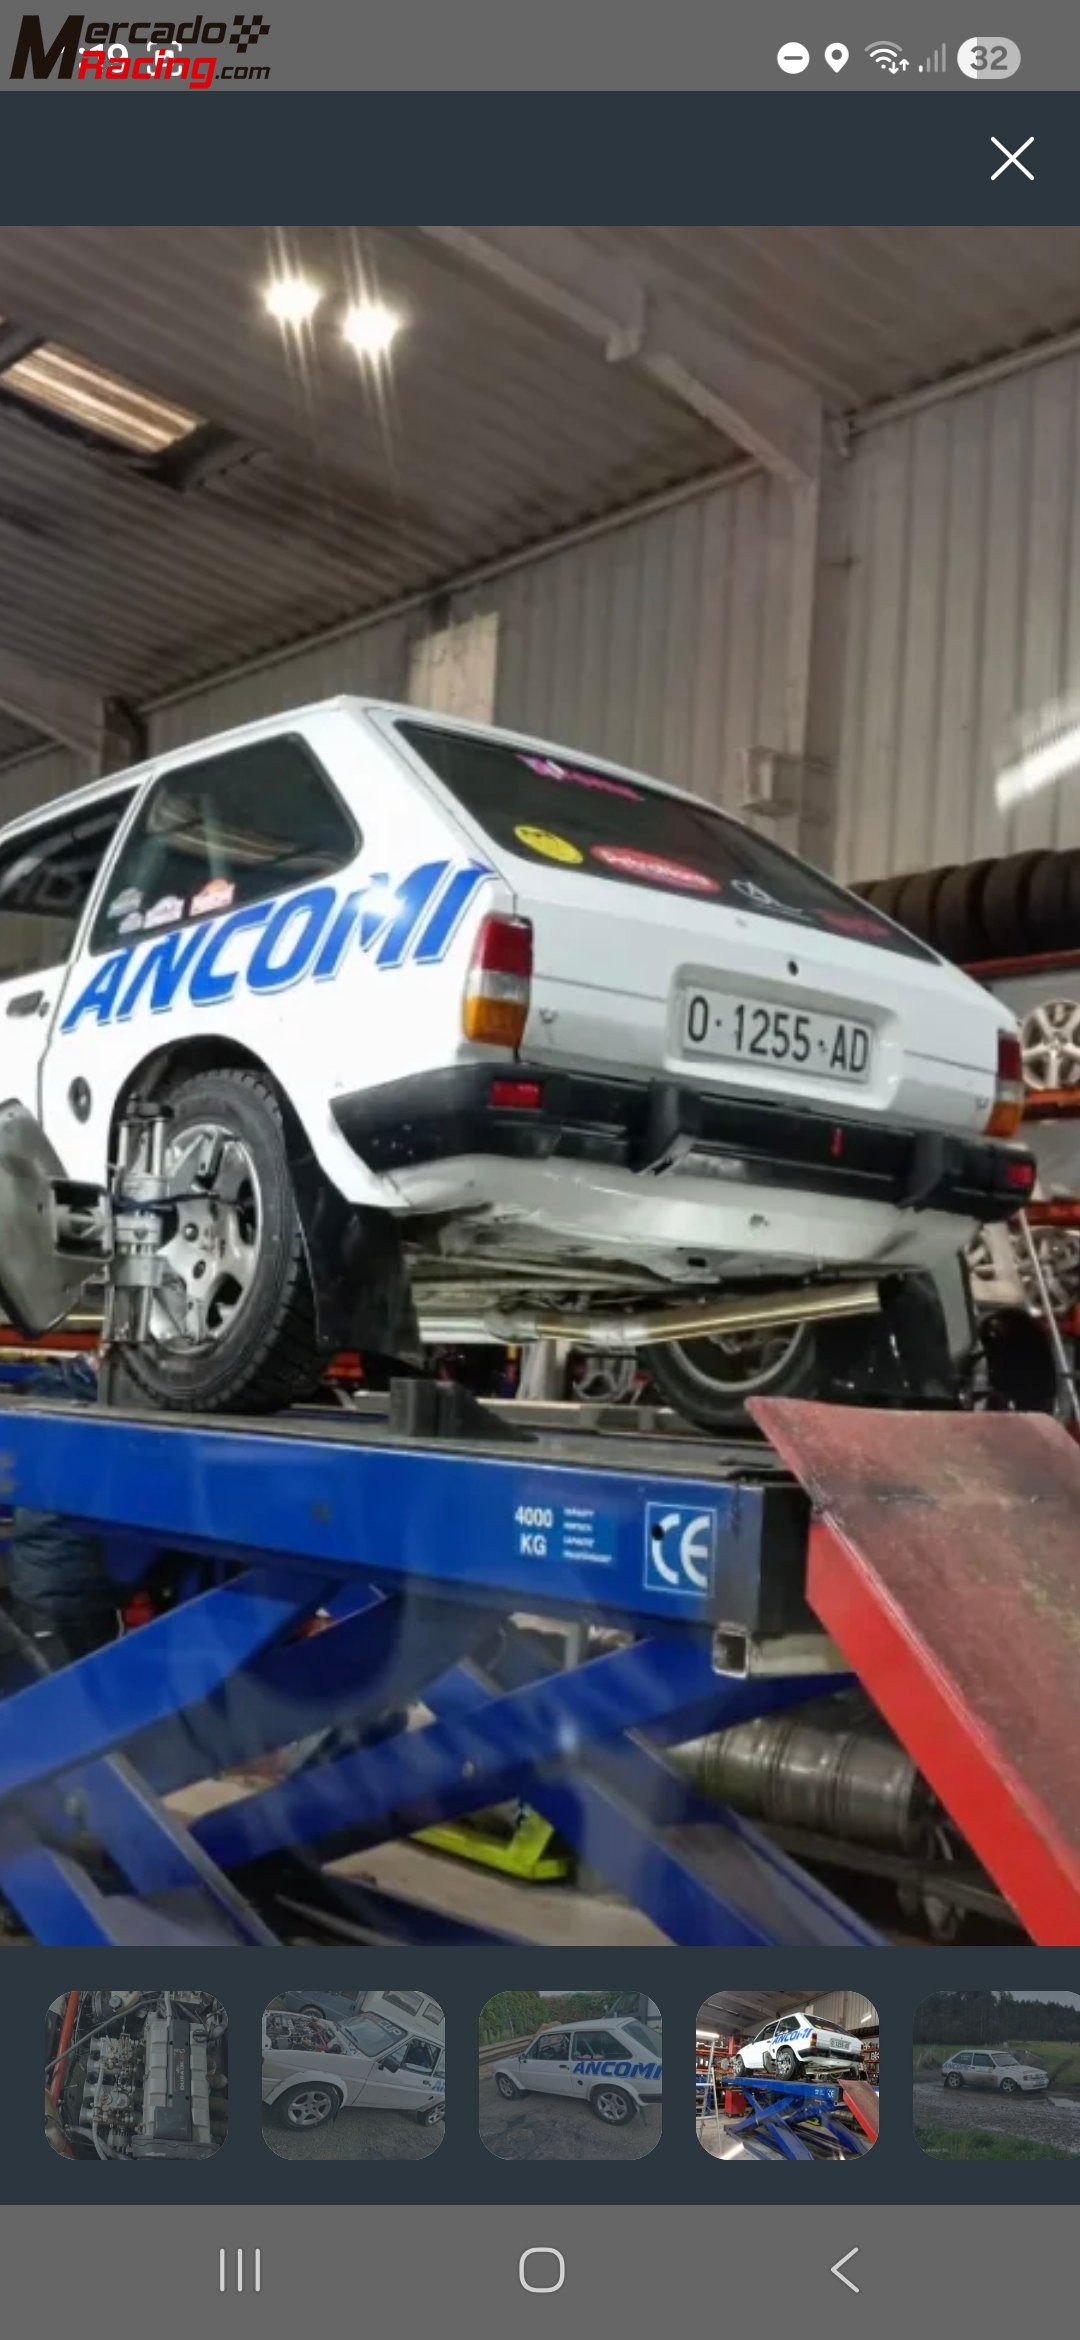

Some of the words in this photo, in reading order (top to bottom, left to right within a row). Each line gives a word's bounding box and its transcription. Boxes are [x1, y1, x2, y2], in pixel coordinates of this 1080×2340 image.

[969, 45, 1008, 71] 32
[60, 859, 499, 1034] ANCOMI
[515, 1506, 553, 1529] 4000
[520, 1533, 547, 1556] KG
[651, 1512, 711, 1587] CE
[573, 2061, 662, 2080] ANCOMI
